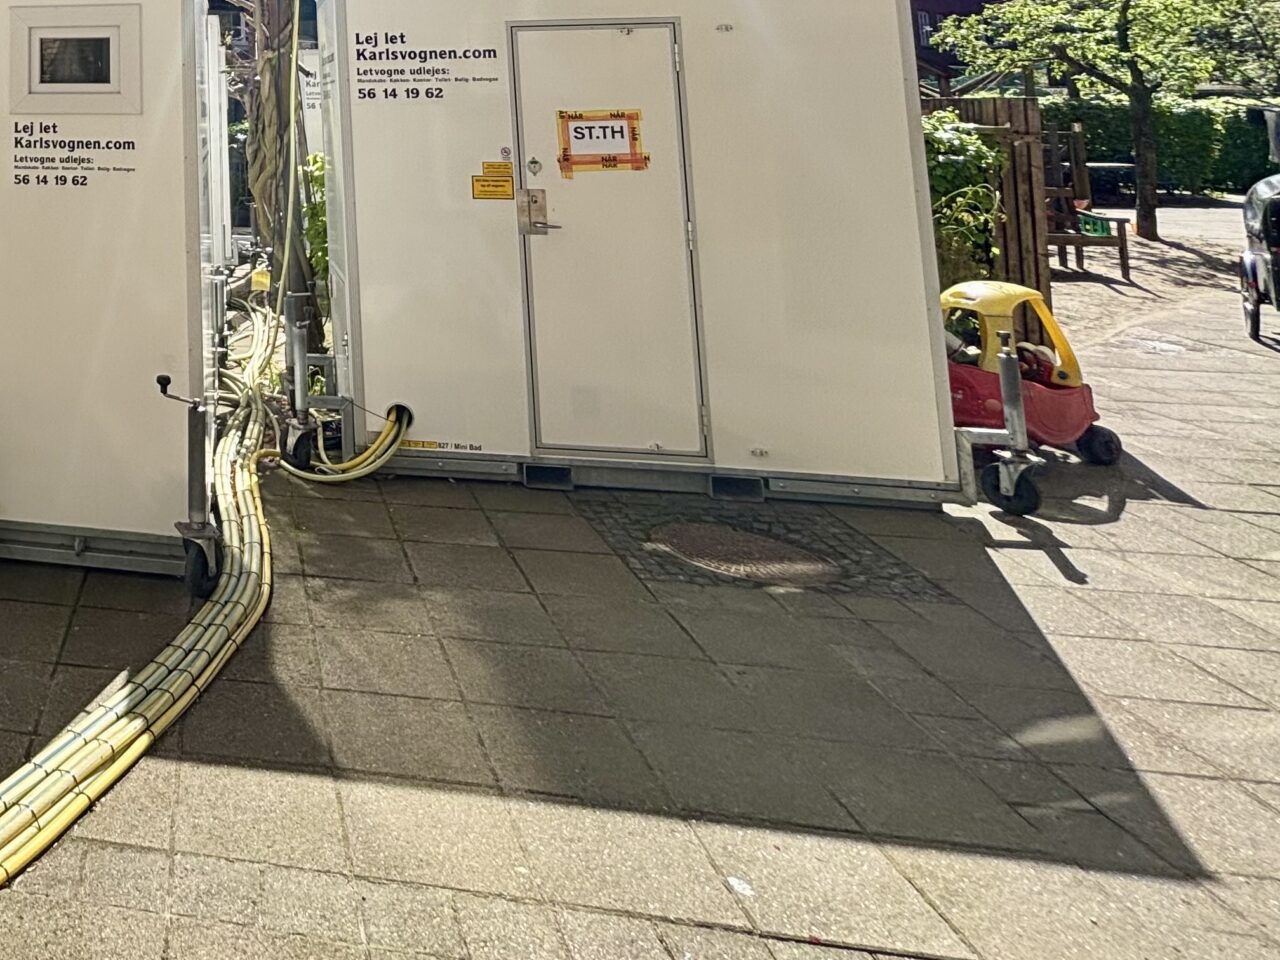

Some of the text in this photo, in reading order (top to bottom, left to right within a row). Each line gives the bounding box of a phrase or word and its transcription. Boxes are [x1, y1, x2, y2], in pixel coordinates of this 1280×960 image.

[355, 32, 406, 47] Lej let
[356, 48, 497, 63] Karlsvognen.com
[357, 66, 450, 77] Letvogne udlejes:
[358, 87, 444, 99] 56 14 19 62
[14, 122, 58, 136] Lej let
[573, 125, 624, 140] ST.TH
[14, 137, 136, 152] Karlsvognen.com
[14, 155, 94, 165] Letvogne udlejes:
[14, 174, 88, 186] 56 14 19 62
